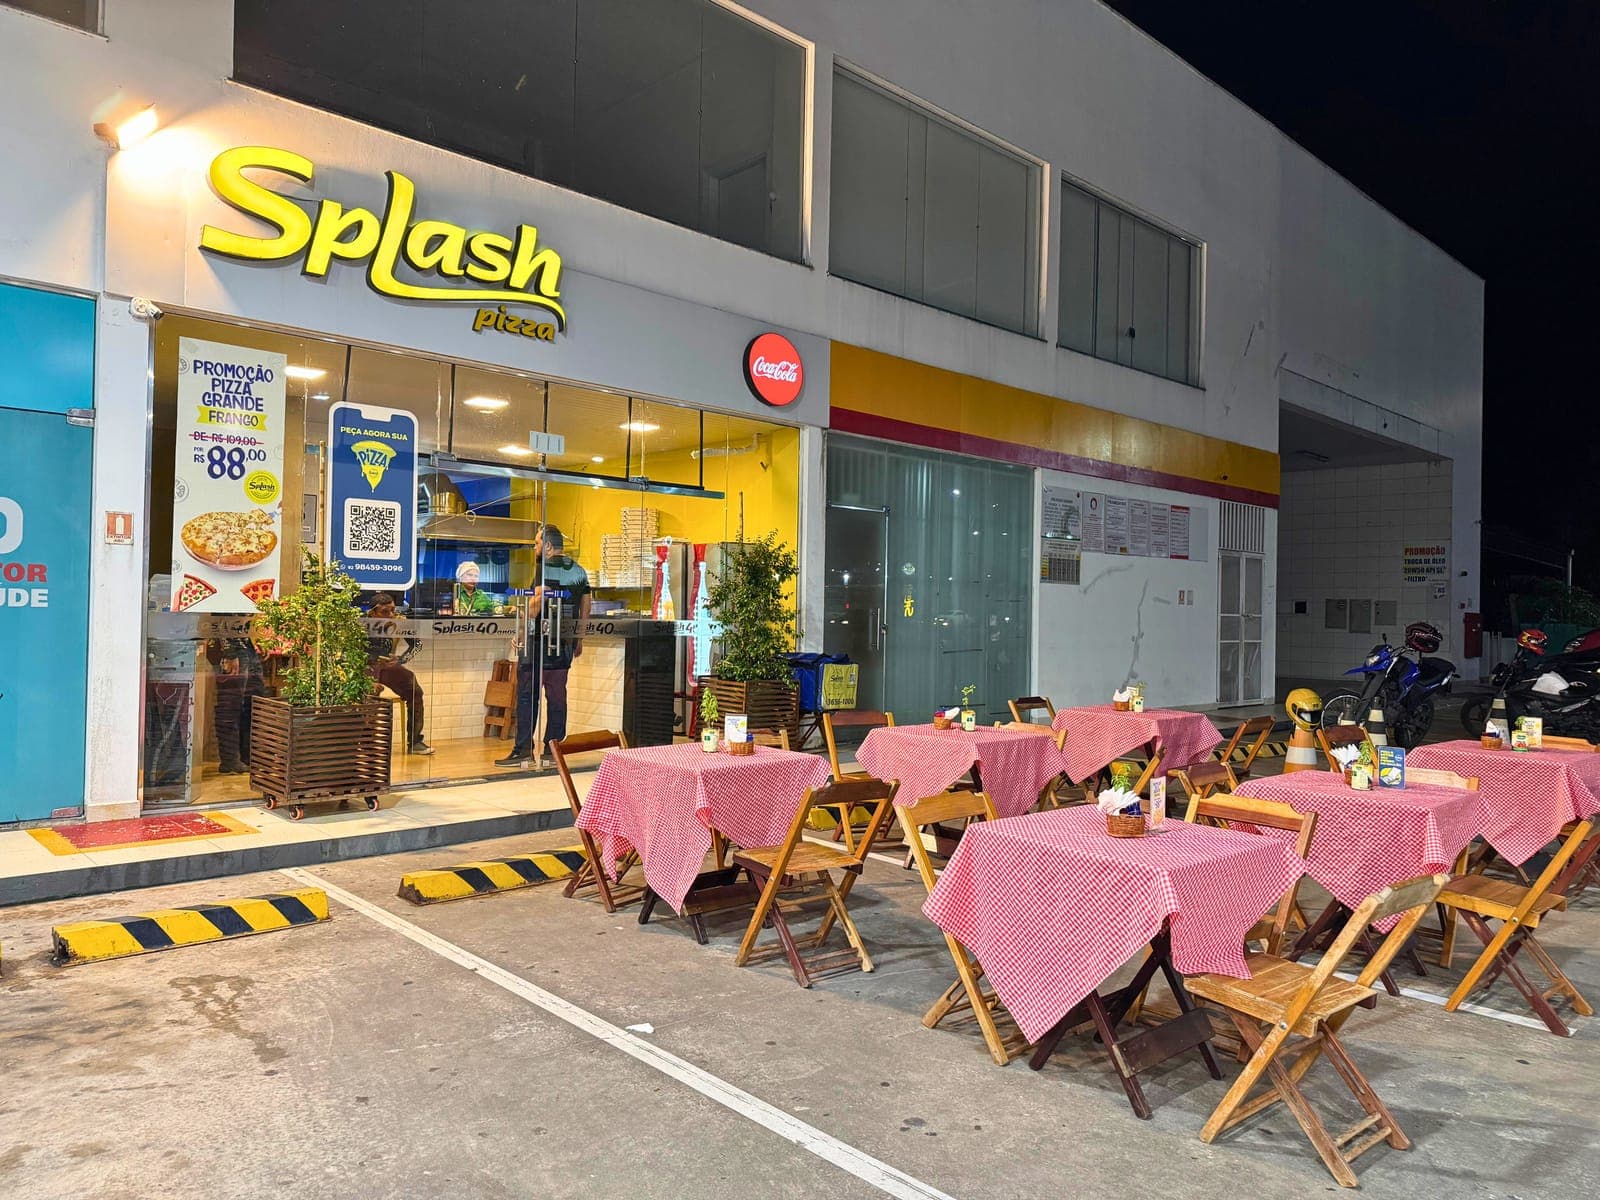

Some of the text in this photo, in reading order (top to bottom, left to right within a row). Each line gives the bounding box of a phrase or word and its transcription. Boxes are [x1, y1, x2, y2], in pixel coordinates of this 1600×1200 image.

[199, 145, 566, 325] Splash
[472, 304, 556, 341] pizza
[193, 360, 274, 383] PROMOÇÃO
[211, 378, 252, 395] PIZZA
[202, 392, 264, 412] GRANDE
[208, 410, 259, 427] FRANGO
[341, 426, 408, 441] PEÇA AGORA SUA
[0, 563, 48, 583] OR
[432, 620, 475, 635] Splash
[476, 622, 498, 635] 40
[596, 622, 615, 636] 40
